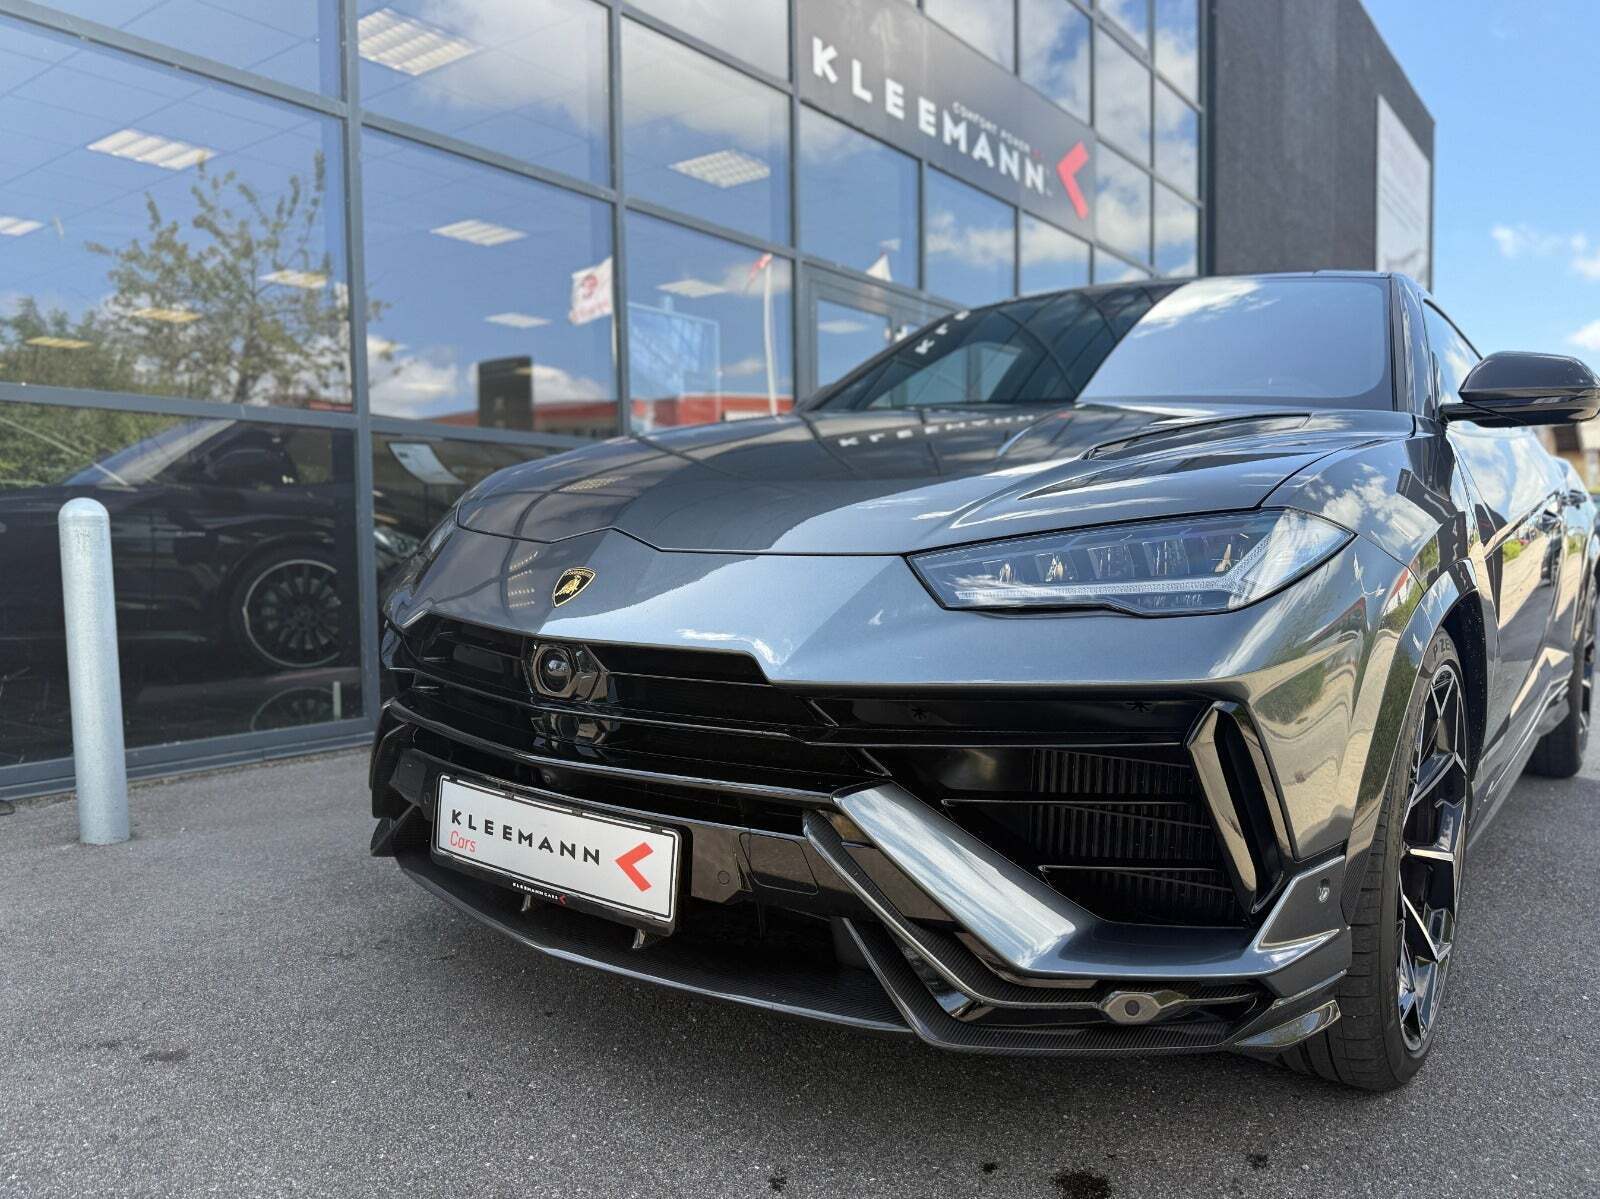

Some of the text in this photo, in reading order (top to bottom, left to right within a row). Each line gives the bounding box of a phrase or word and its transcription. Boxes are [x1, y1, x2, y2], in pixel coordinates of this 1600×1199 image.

[812, 36, 1045, 195] KLEEMANN
[450, 830, 476, 853] Cars
[451, 809, 600, 866] KLEEMANN
